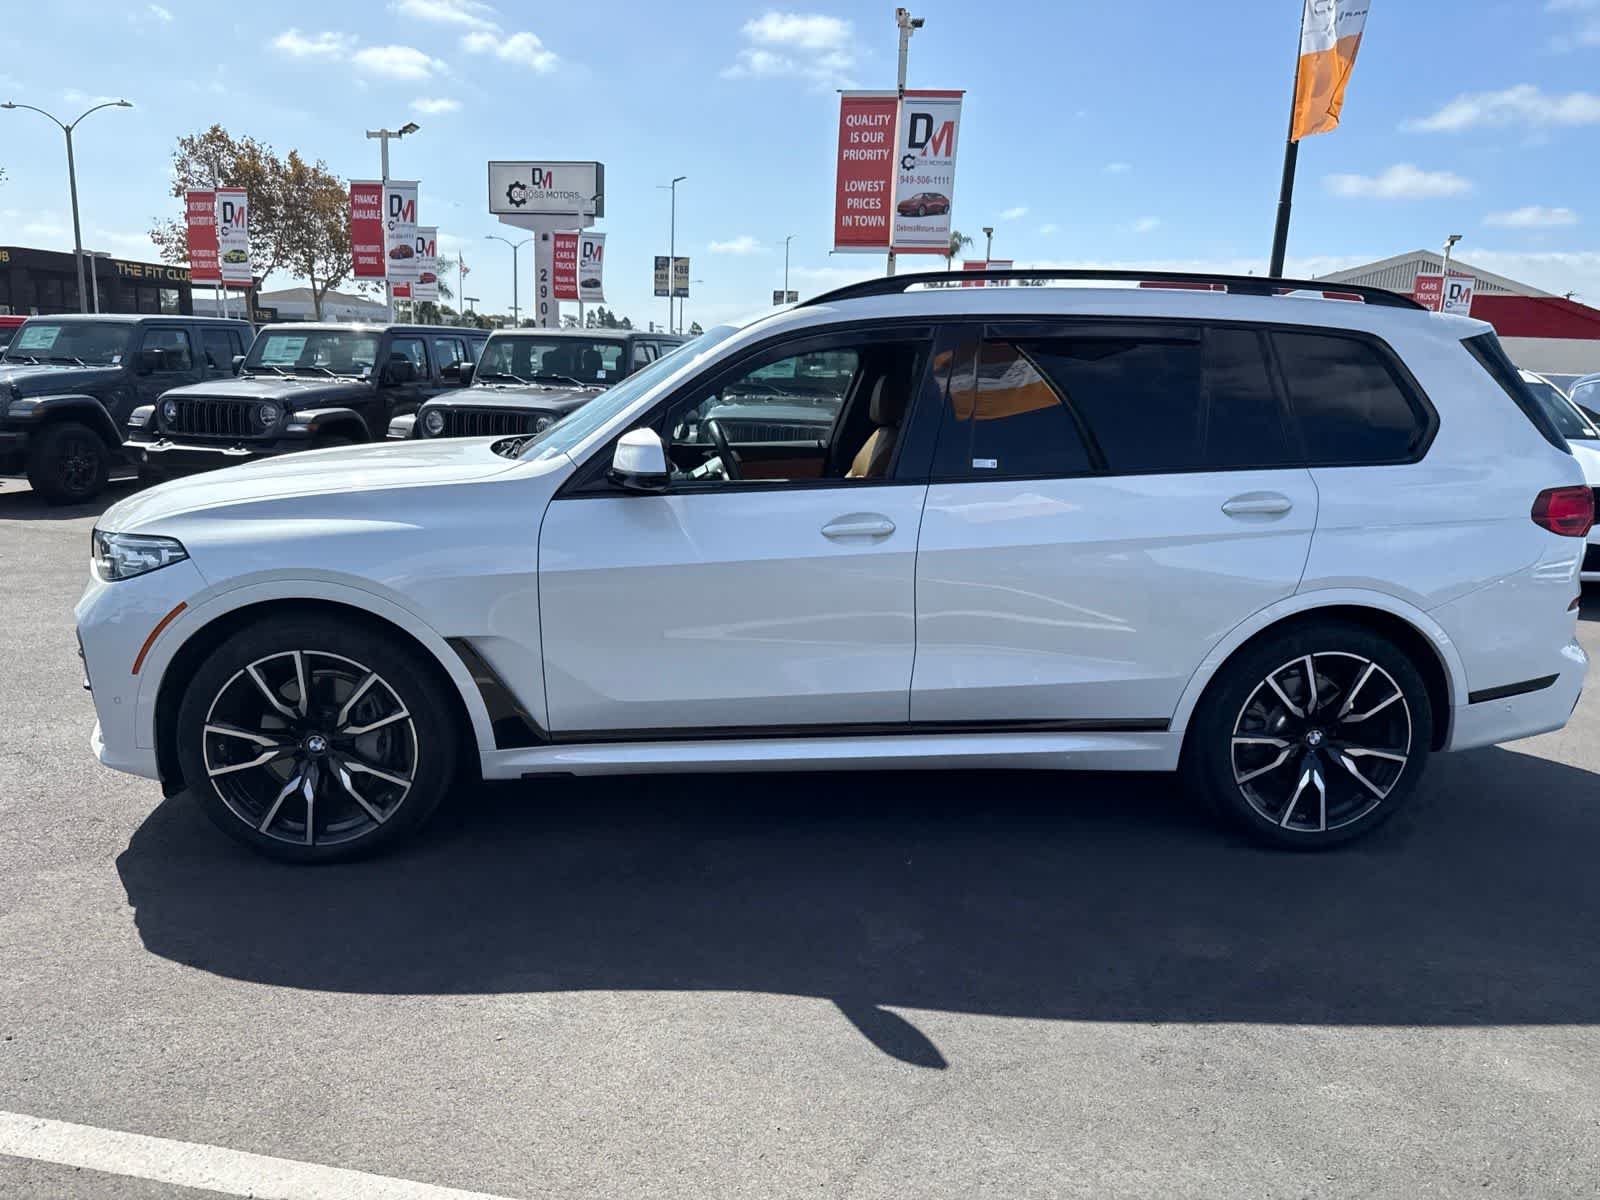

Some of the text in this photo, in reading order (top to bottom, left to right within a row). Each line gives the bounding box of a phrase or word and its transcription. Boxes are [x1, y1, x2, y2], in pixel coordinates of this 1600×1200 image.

[846, 114, 891, 127] QUALITY
[850, 131, 884, 143] IS OUR
[843, 149, 889, 160] PRIORITY
[845, 180, 885, 192] LOWEST
[354, 194, 378, 205] FINANCE
[546, 191, 580, 200] MOTORS
[847, 198, 881, 209] PRICES
[842, 215, 885, 227] IN TOWN
[115, 262, 142, 277] THE
[144, 265, 164, 279] FIT
[1421, 282, 1438, 290] CARS
